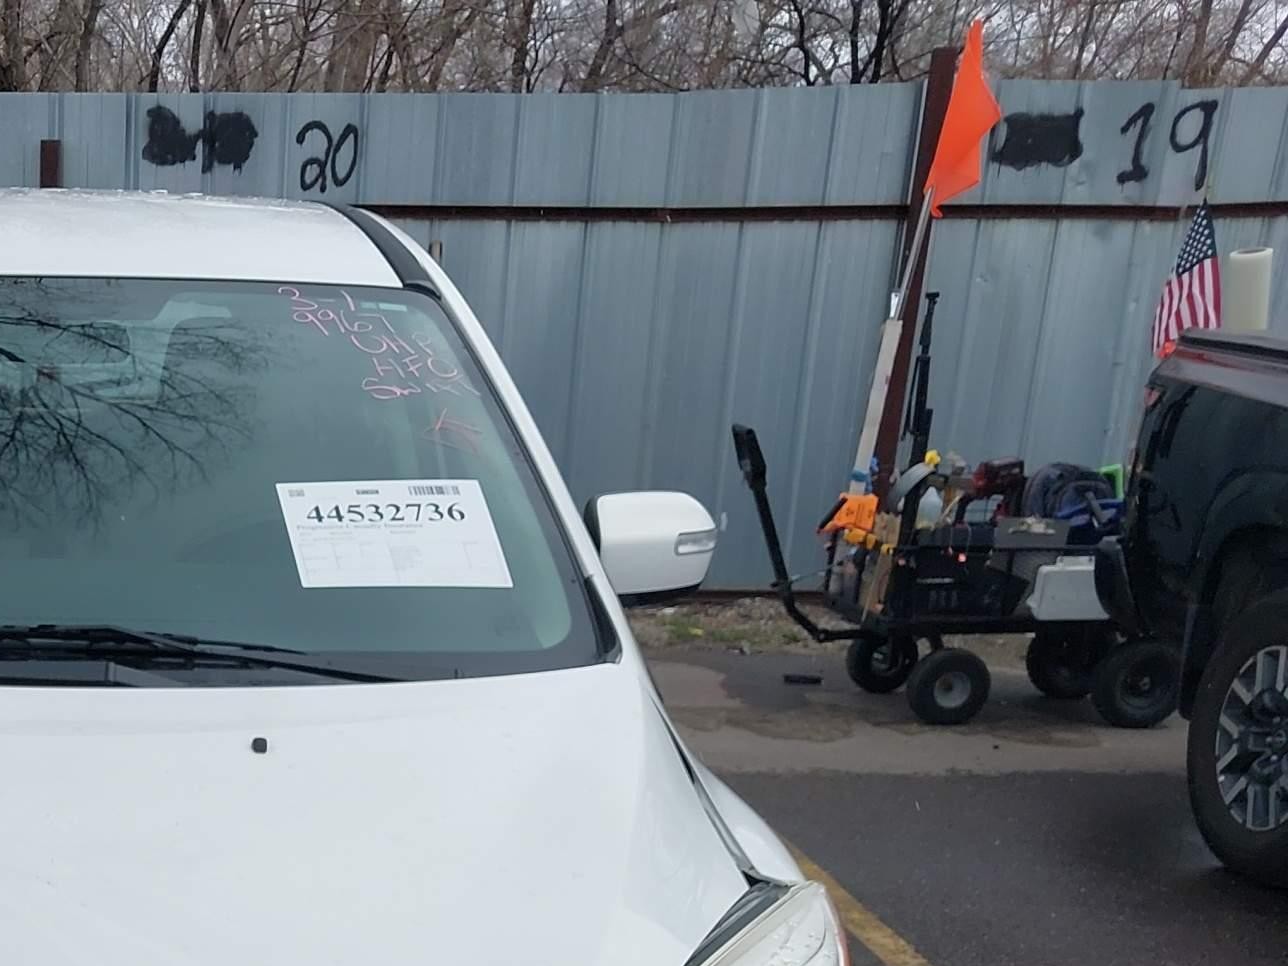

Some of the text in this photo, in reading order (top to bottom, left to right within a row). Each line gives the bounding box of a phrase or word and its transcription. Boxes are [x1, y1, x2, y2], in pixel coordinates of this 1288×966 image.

[296, 120, 359, 193] 20
[1117, 101, 1219, 192] 19
[306, 502, 466, 523] 44532736
